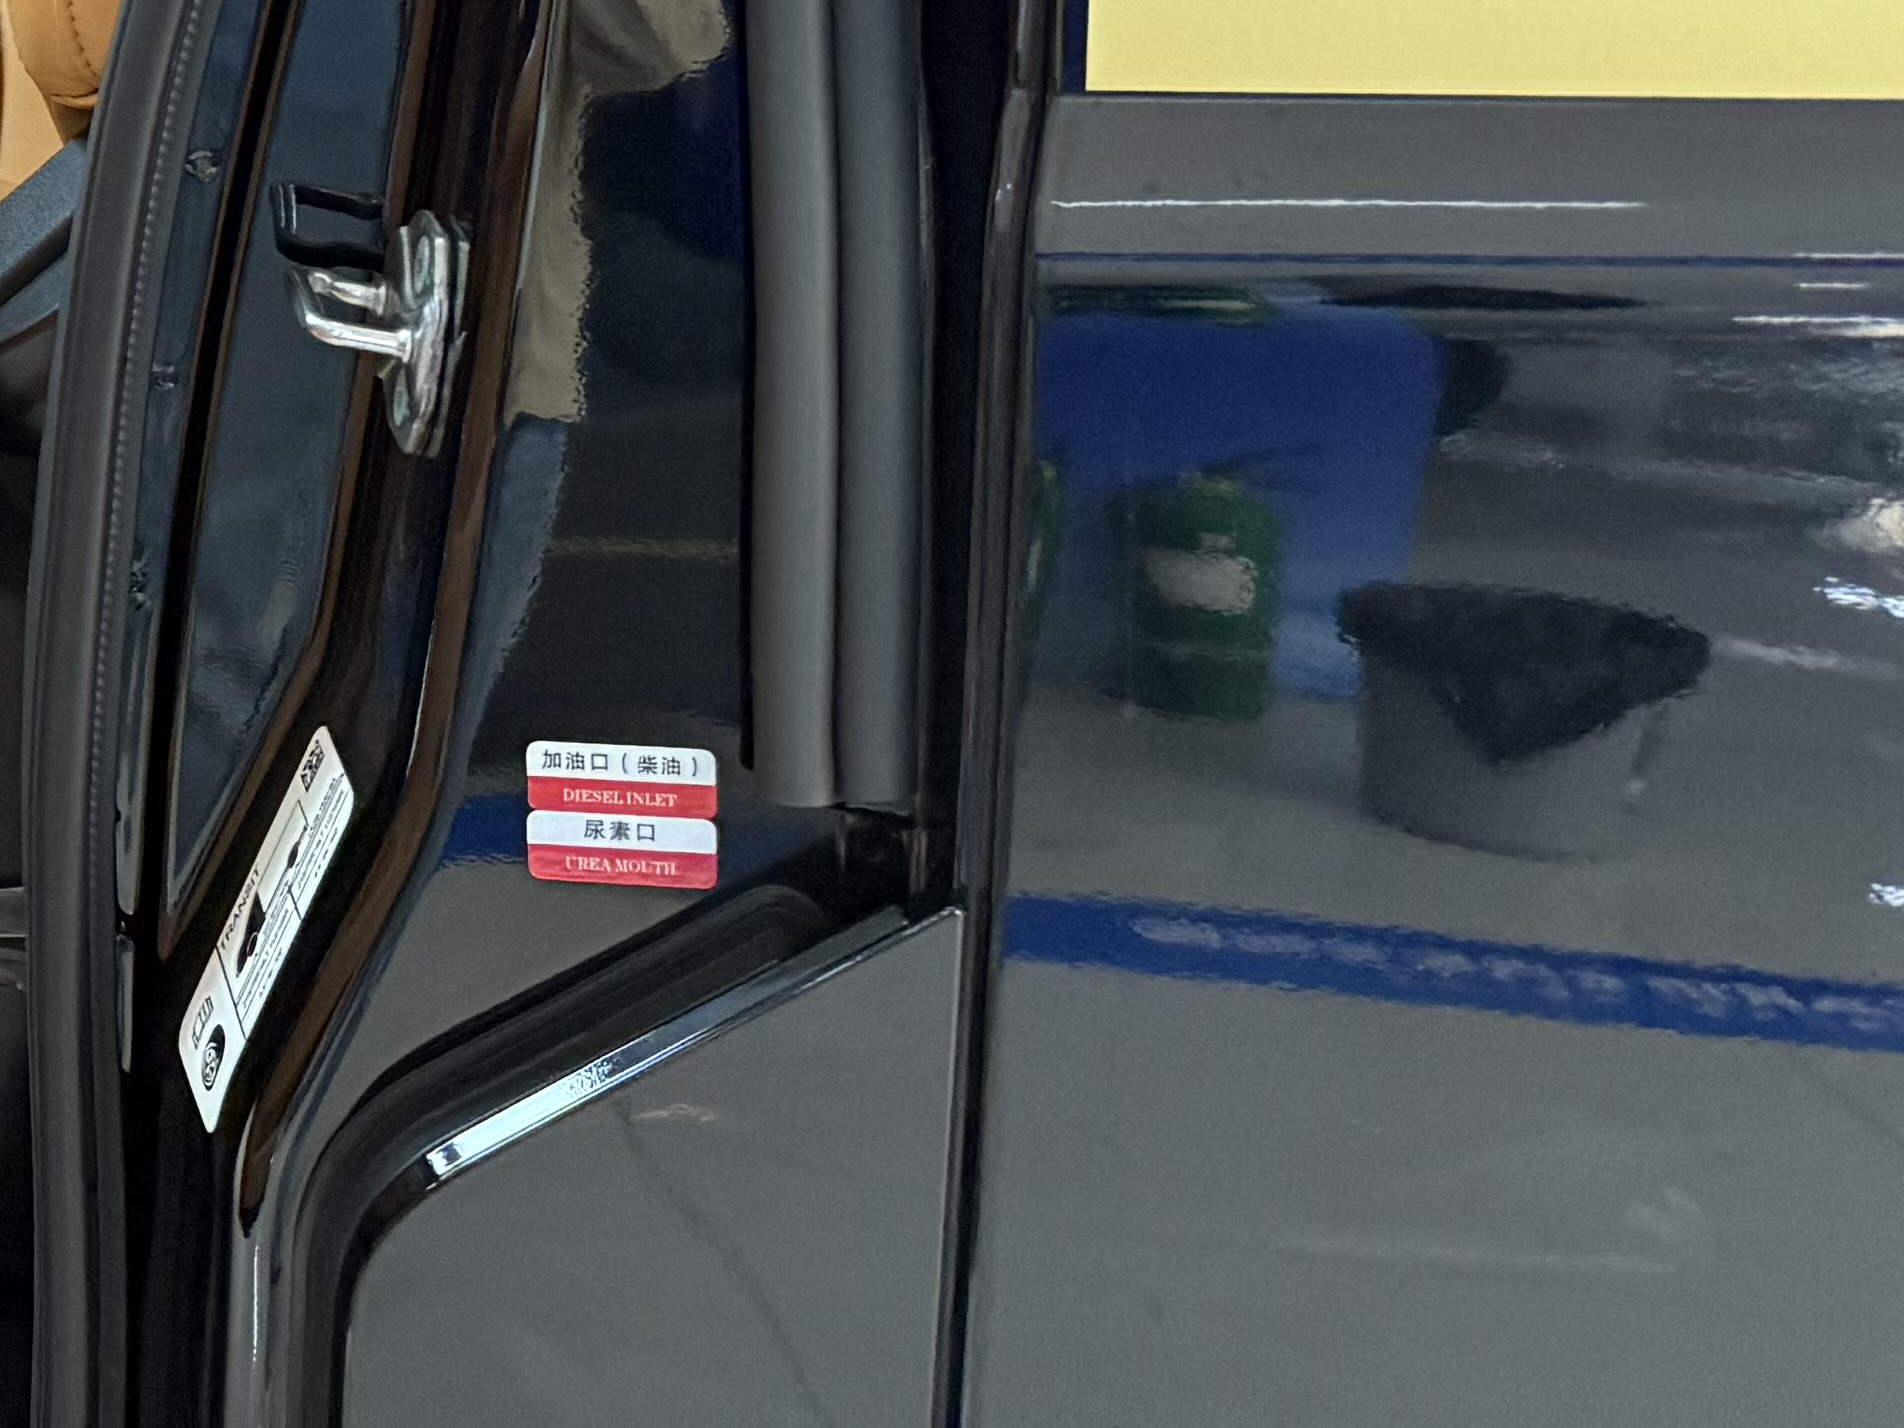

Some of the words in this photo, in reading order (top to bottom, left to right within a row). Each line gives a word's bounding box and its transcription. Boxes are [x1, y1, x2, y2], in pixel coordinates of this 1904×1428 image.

[563, 787, 624, 804] DIESEL
[626, 792, 678, 807] INLET
[584, 819, 656, 841] 尿素口
[565, 855, 612, 872] UREA
[614, 859, 677, 875] MOUTH
[216, 866, 262, 950] TRANSIT
